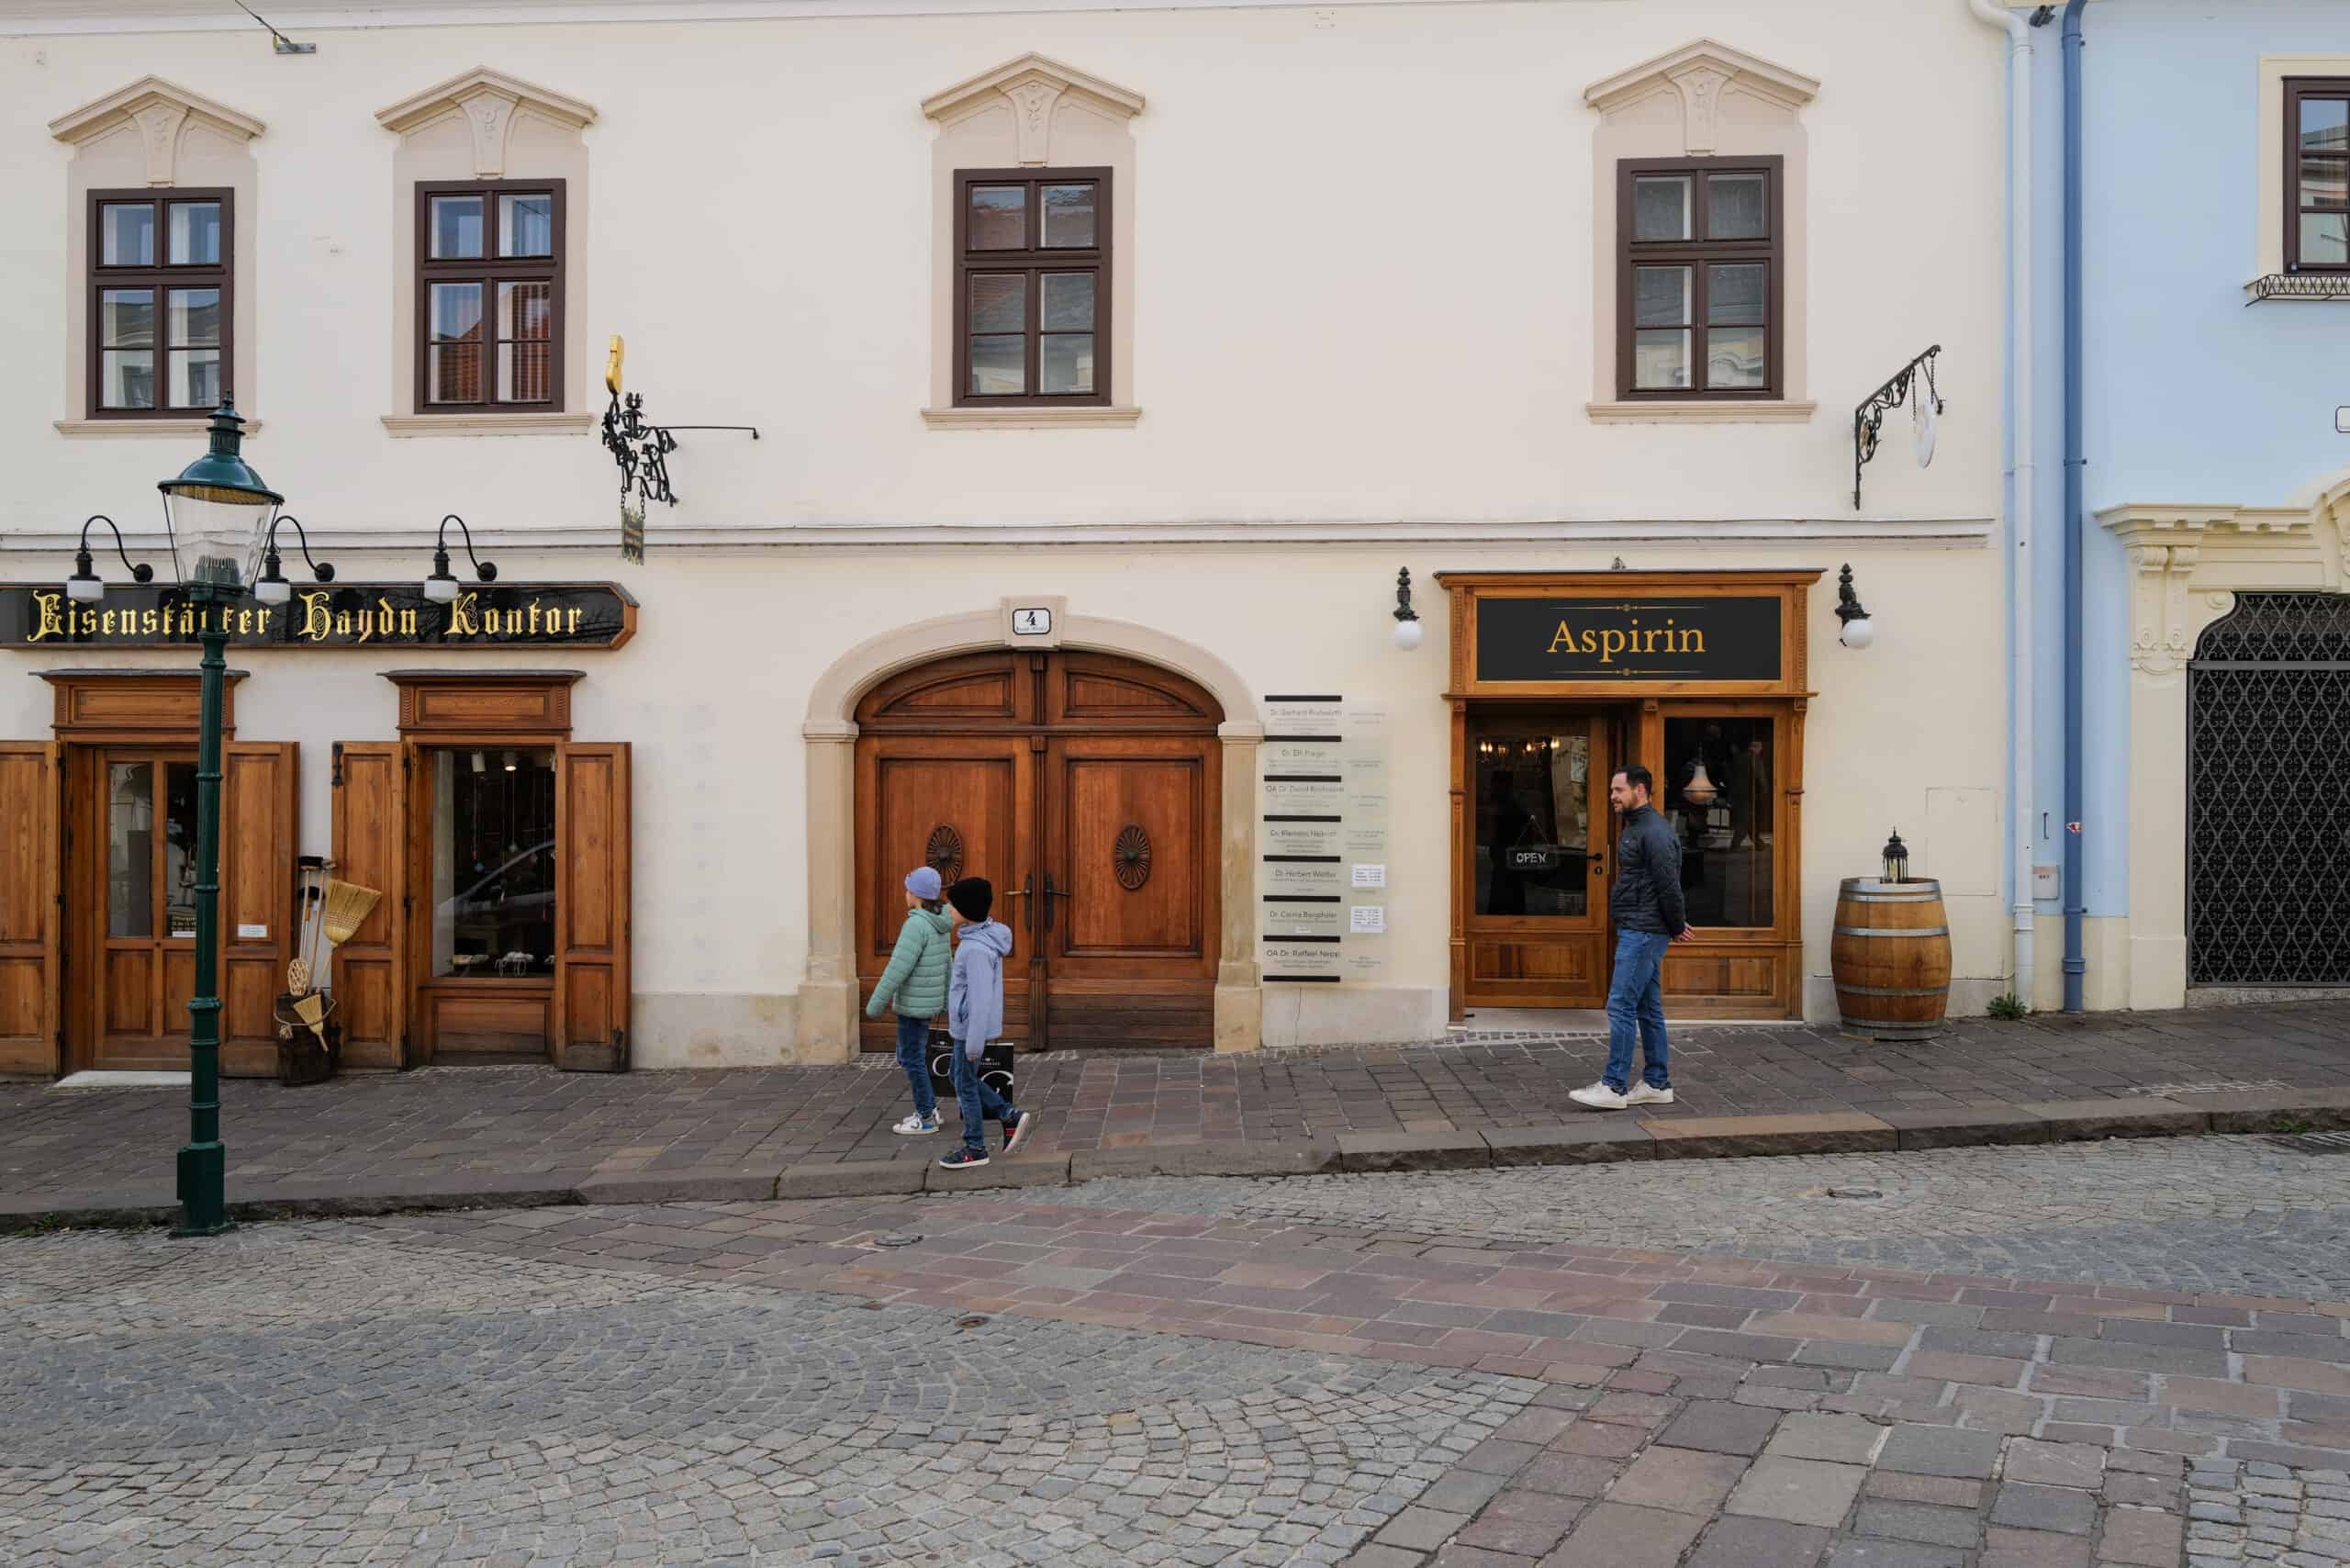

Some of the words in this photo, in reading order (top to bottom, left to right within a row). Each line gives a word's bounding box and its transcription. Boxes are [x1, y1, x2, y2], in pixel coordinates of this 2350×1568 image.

[27, 589, 273, 642] Eisenstäter
[297, 591, 417, 644] Haydn
[443, 592, 582, 635] Kontor
[1025, 610, 1036, 626] 4
[1546, 618, 1707, 663] Aspirin
[1516, 852, 1547, 864] OPEN
